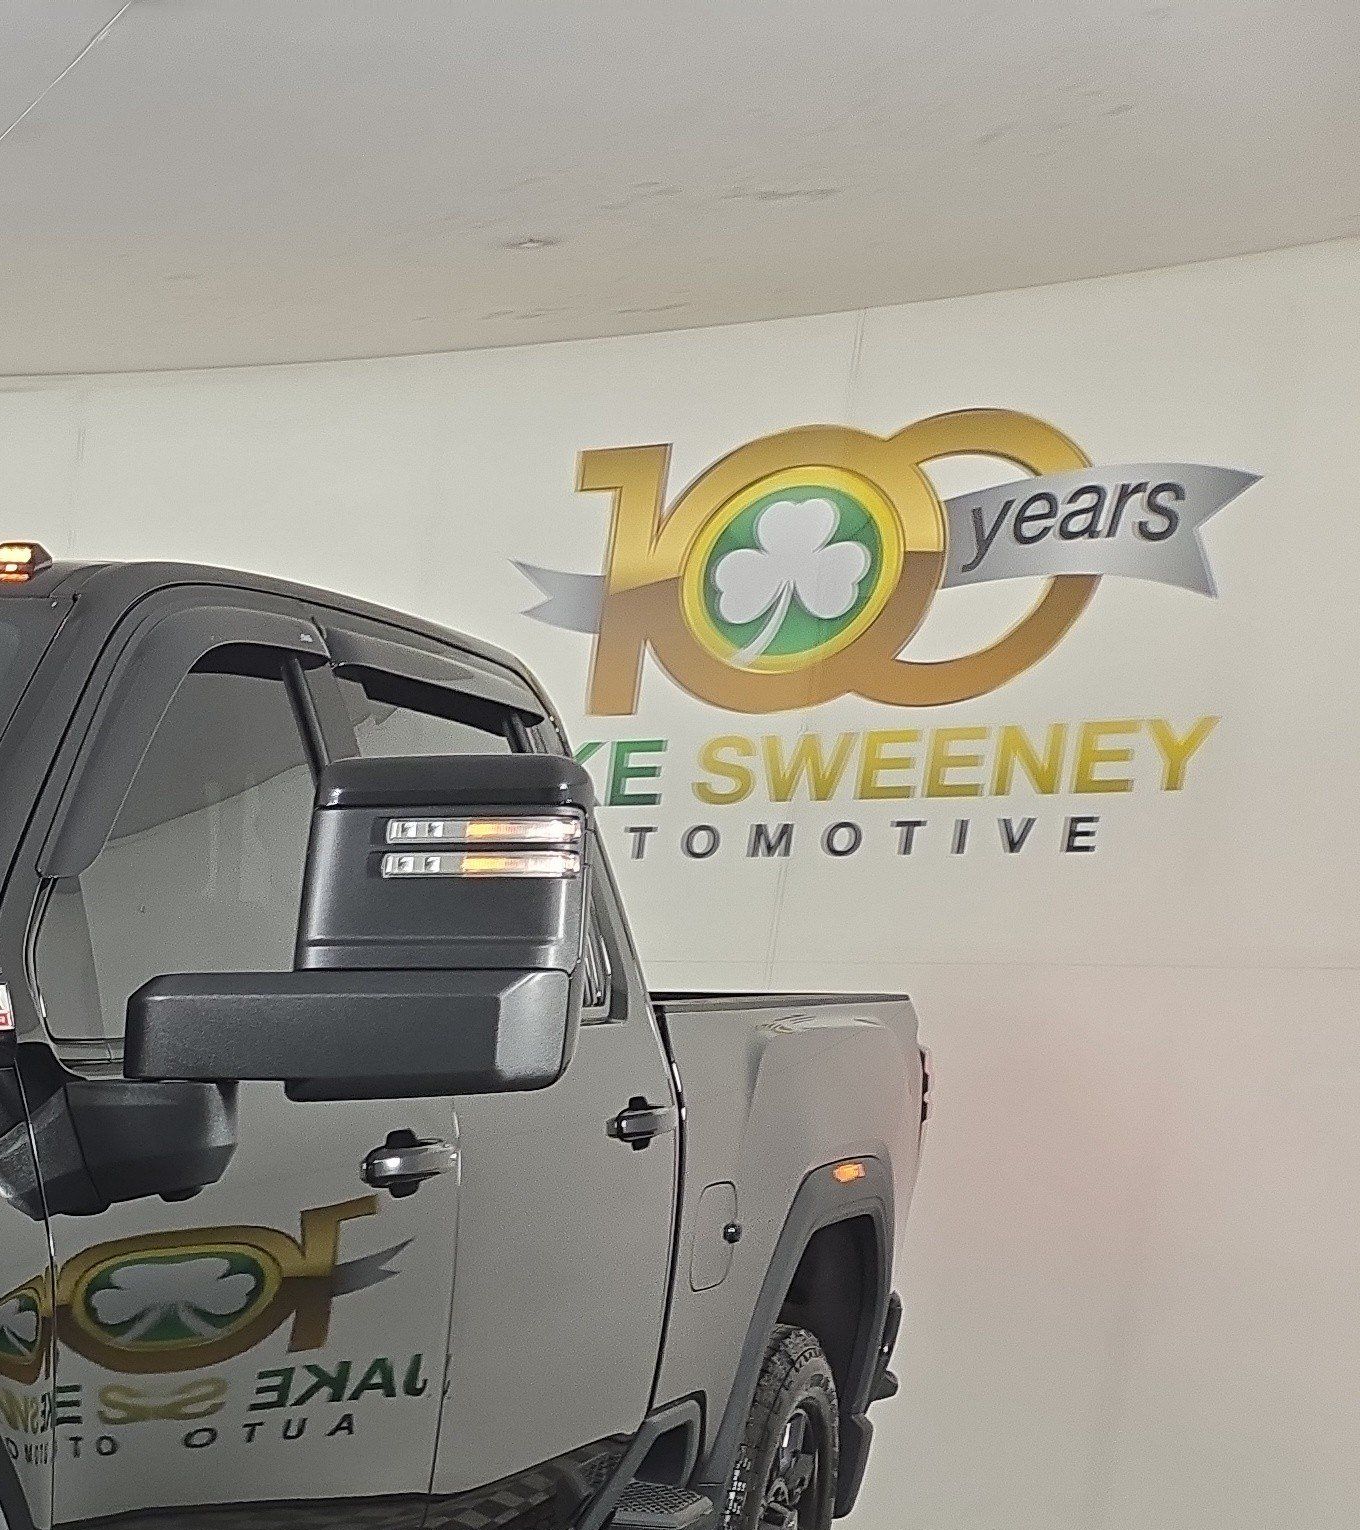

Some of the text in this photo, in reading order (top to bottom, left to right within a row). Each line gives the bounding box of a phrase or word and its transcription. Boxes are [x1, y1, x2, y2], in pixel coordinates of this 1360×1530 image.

[576, 407, 1106, 717] 100
[961, 479, 1187, 573] years
[691, 715, 1221, 806] SWEENEY
[624, 815, 1101, 860] TOMOTIVE
